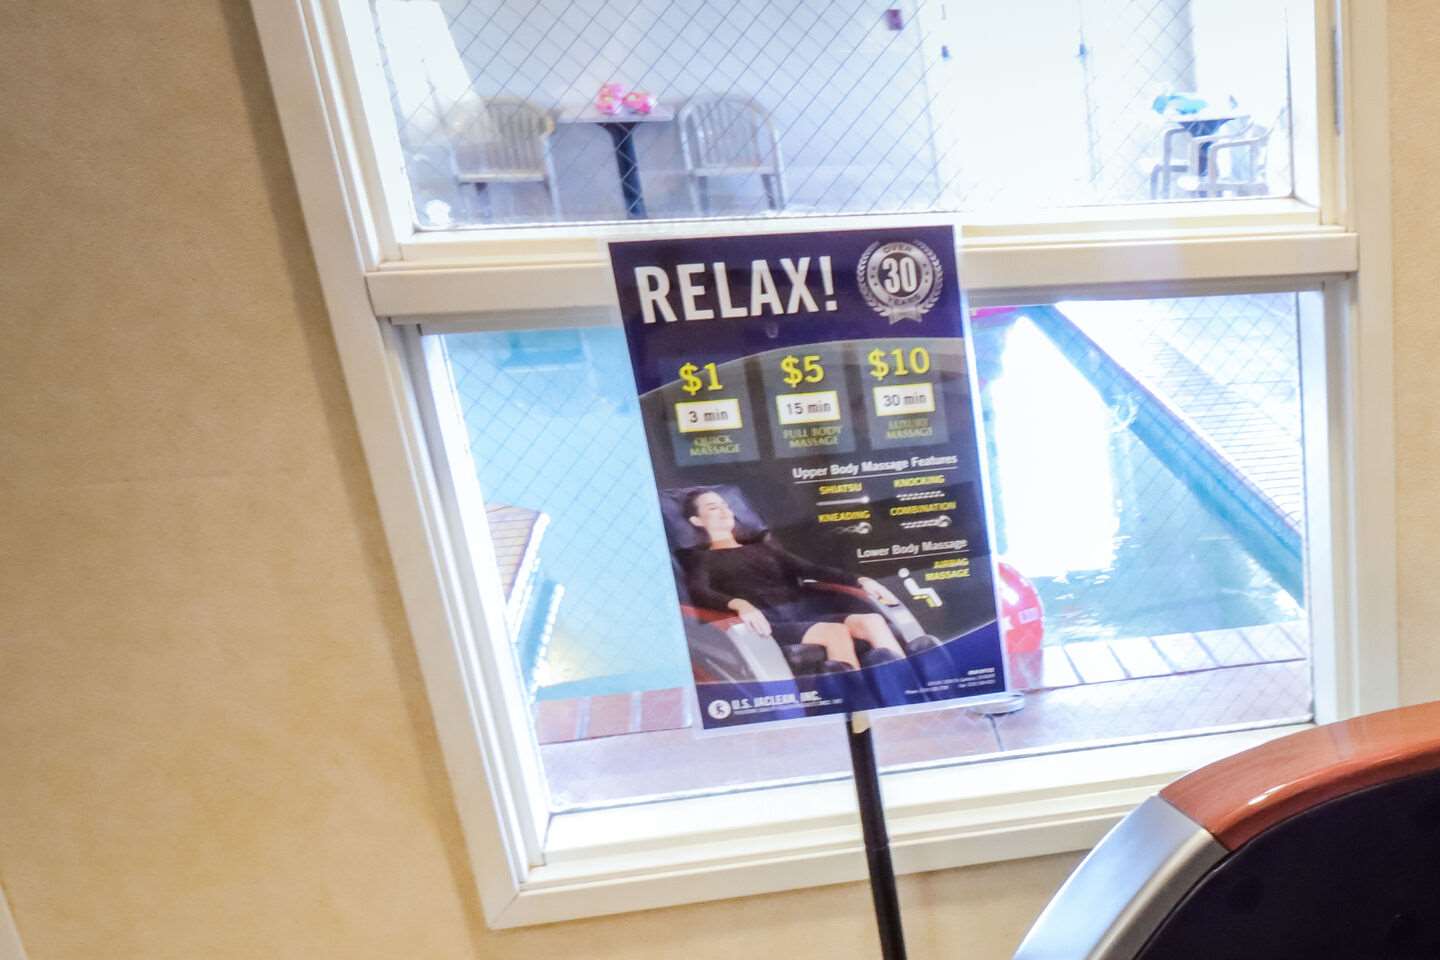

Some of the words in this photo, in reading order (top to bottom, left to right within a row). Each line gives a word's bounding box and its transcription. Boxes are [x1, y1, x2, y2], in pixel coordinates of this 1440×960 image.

[882, 256, 918, 294] 30
[634, 256, 838, 323] RELAX!
[780, 354, 824, 388] $5
[867, 347, 931, 381] $10
[679, 362, 724, 396] $1
[882, 395, 901, 407] 30
[903, 393, 928, 405] min
[786, 403, 804, 415] 15
[807, 401, 832, 413] min
[687, 410, 698, 423] 3
[703, 409, 729, 422] min
[783, 428, 808, 440] FULL
[789, 435, 839, 448] MASSAGE
[792, 465, 827, 480] Upper
[831, 463, 860, 477] Body
[861, 458, 909, 472] Massage
[911, 455, 958, 467] Features
[818, 483, 863, 495] SHIATSU
[889, 501, 957, 516] COMBINATION
[817, 510, 871, 523] KNEADING
[856, 547, 890, 559] Lower
[891, 544, 920, 555] Body
[922, 539, 968, 552] Massage
[924, 568, 970, 582] MASSAGE
[731, 698, 751, 710] U.S.
